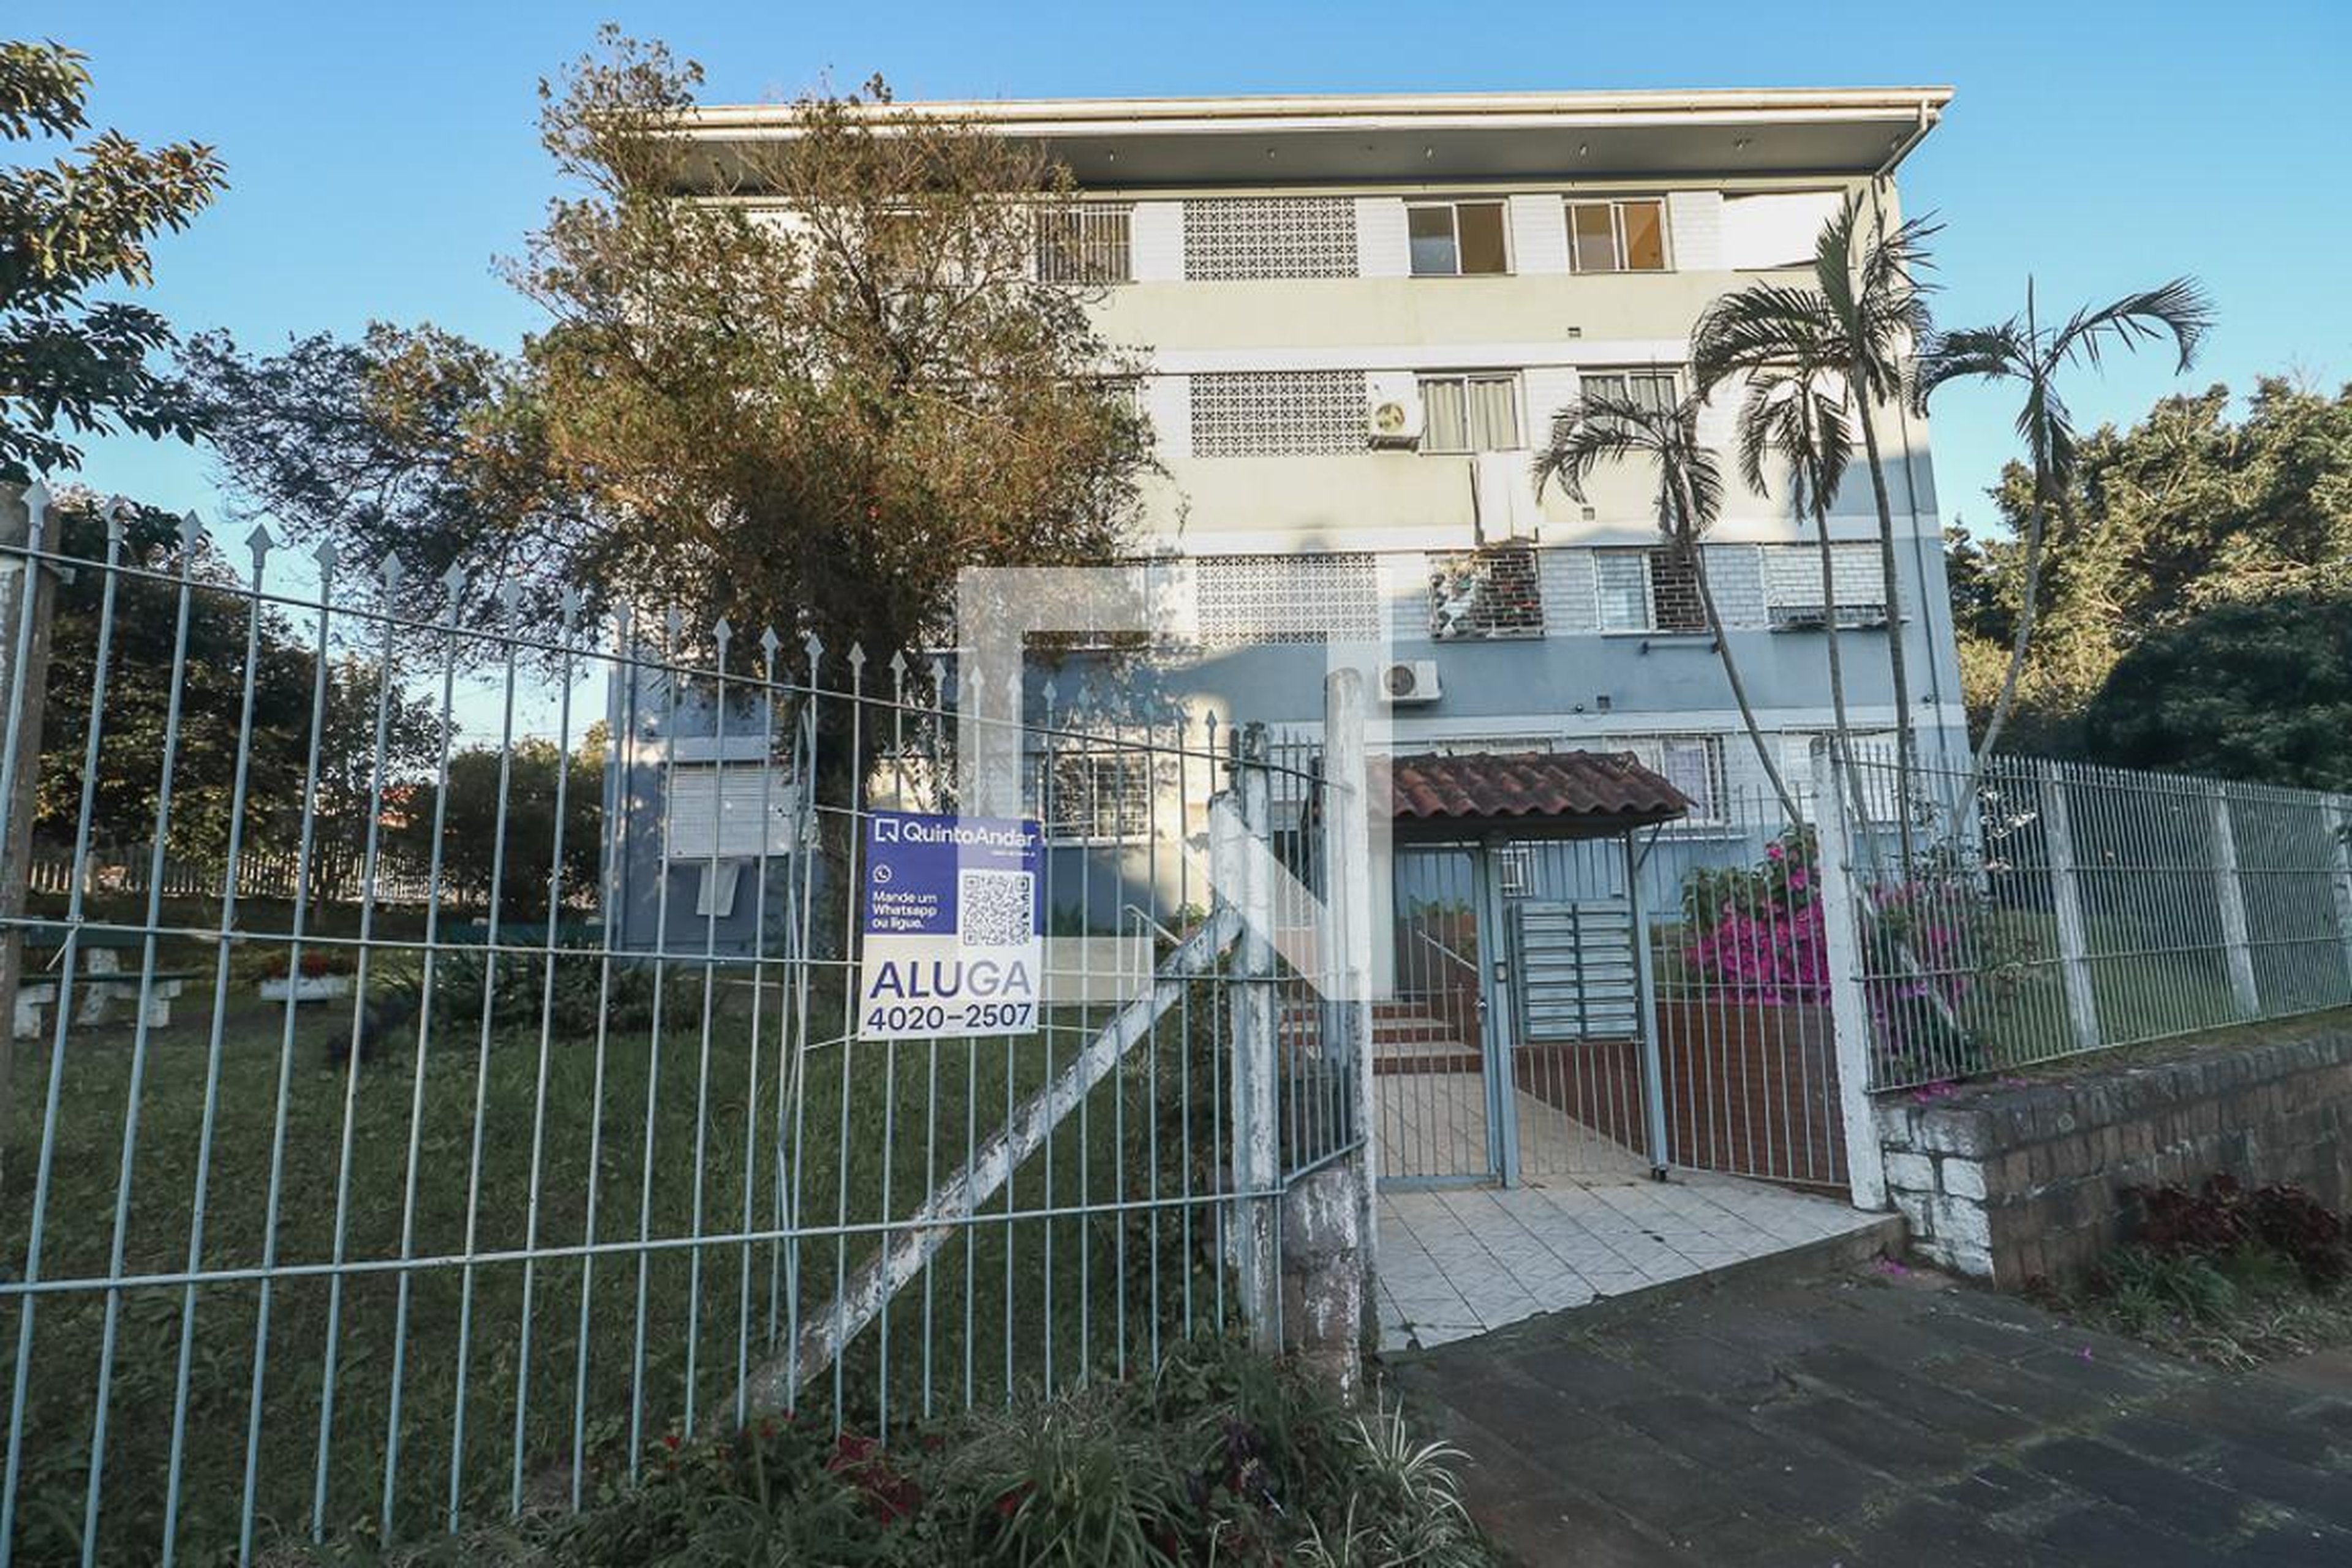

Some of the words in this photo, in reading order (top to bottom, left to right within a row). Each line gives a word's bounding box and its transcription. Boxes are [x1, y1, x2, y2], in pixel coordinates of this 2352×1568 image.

[903, 822, 1036, 847] QuintoAndar
[873, 891, 916, 903] Mande
[918, 894, 938, 903] um
[872, 919, 889, 929] ou
[869, 960, 1031, 998] ALUGA
